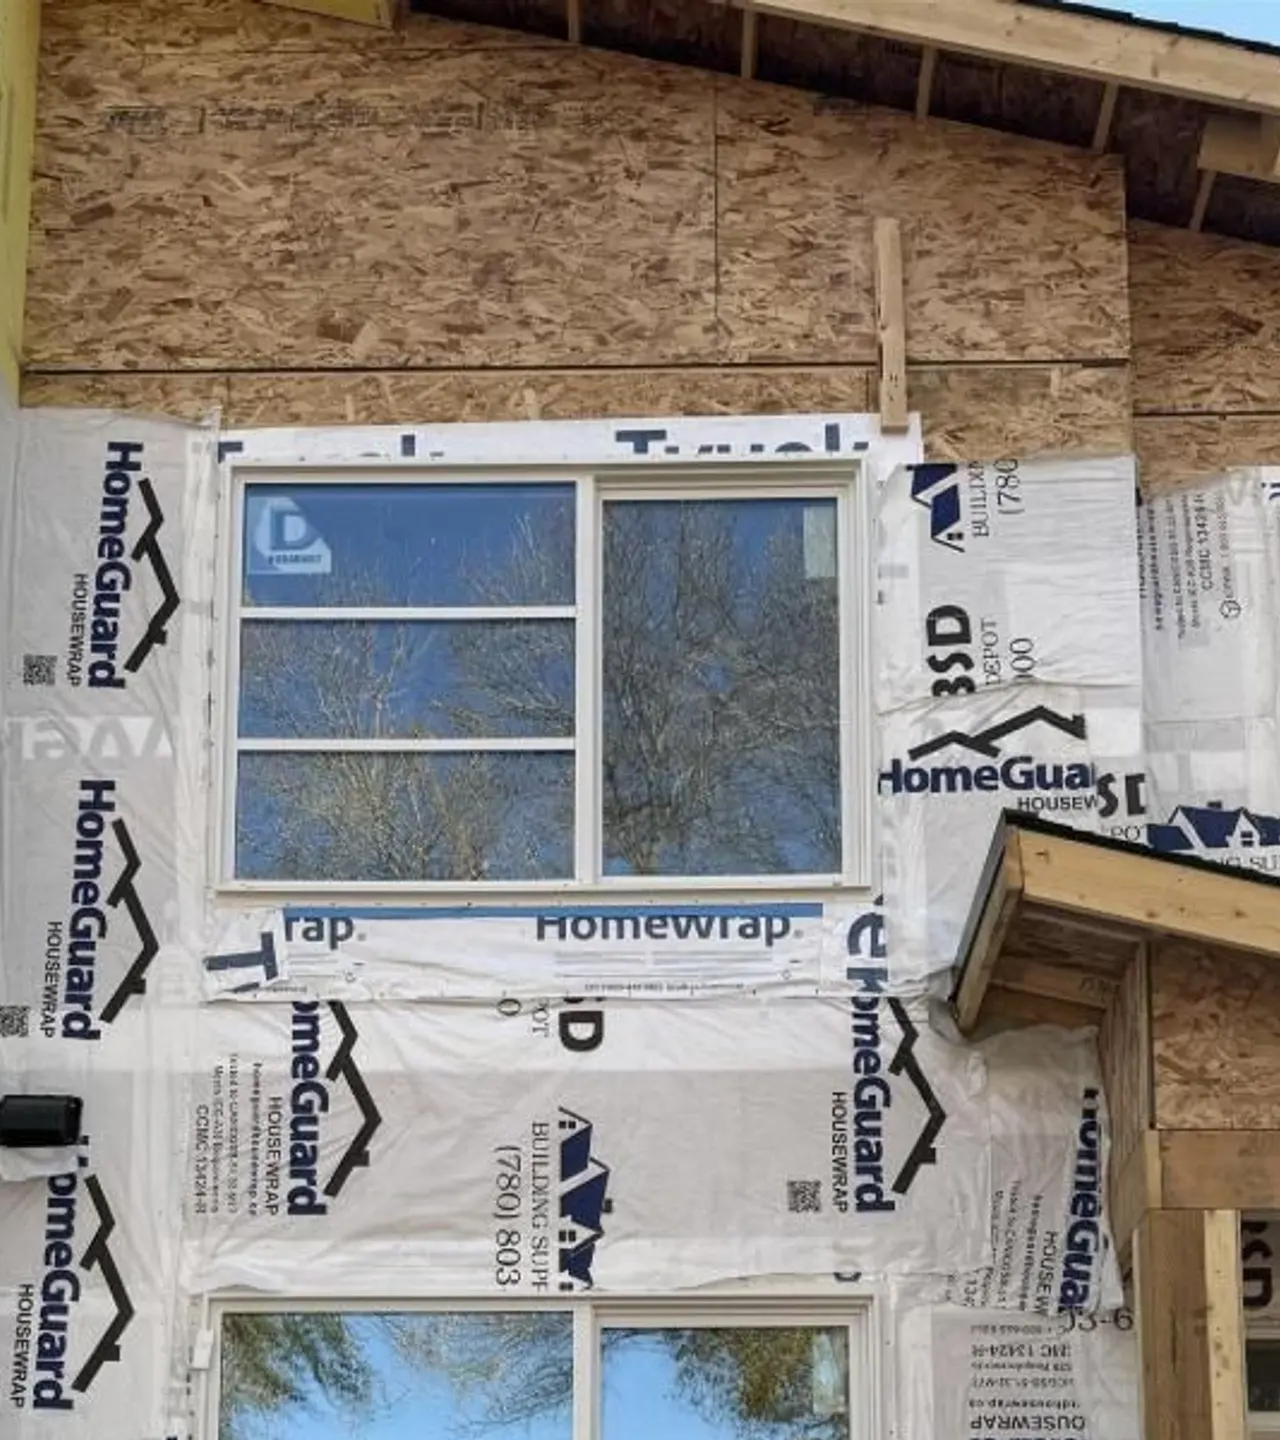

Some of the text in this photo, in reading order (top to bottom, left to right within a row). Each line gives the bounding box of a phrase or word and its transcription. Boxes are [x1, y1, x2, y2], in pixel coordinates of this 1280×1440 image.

[88, 441, 144, 689] HomeGuard
[68, 573, 88, 687] HOUSEWRAP
[61, 779, 116, 1040] HomeGuard
[40, 921, 63, 1038] HOUSEWRAP
[266, 1097, 283, 1217] HOUSEWRAP
[494, 1145, 521, 1219] (780)
[532, 1122, 550, 1229] BUILDING
[832, 1091, 848, 1213] HOUSEWRAP
[32, 1136, 89, 1411] omeGuard
[10, 1283, 34, 1409] HOUSEWRAP
